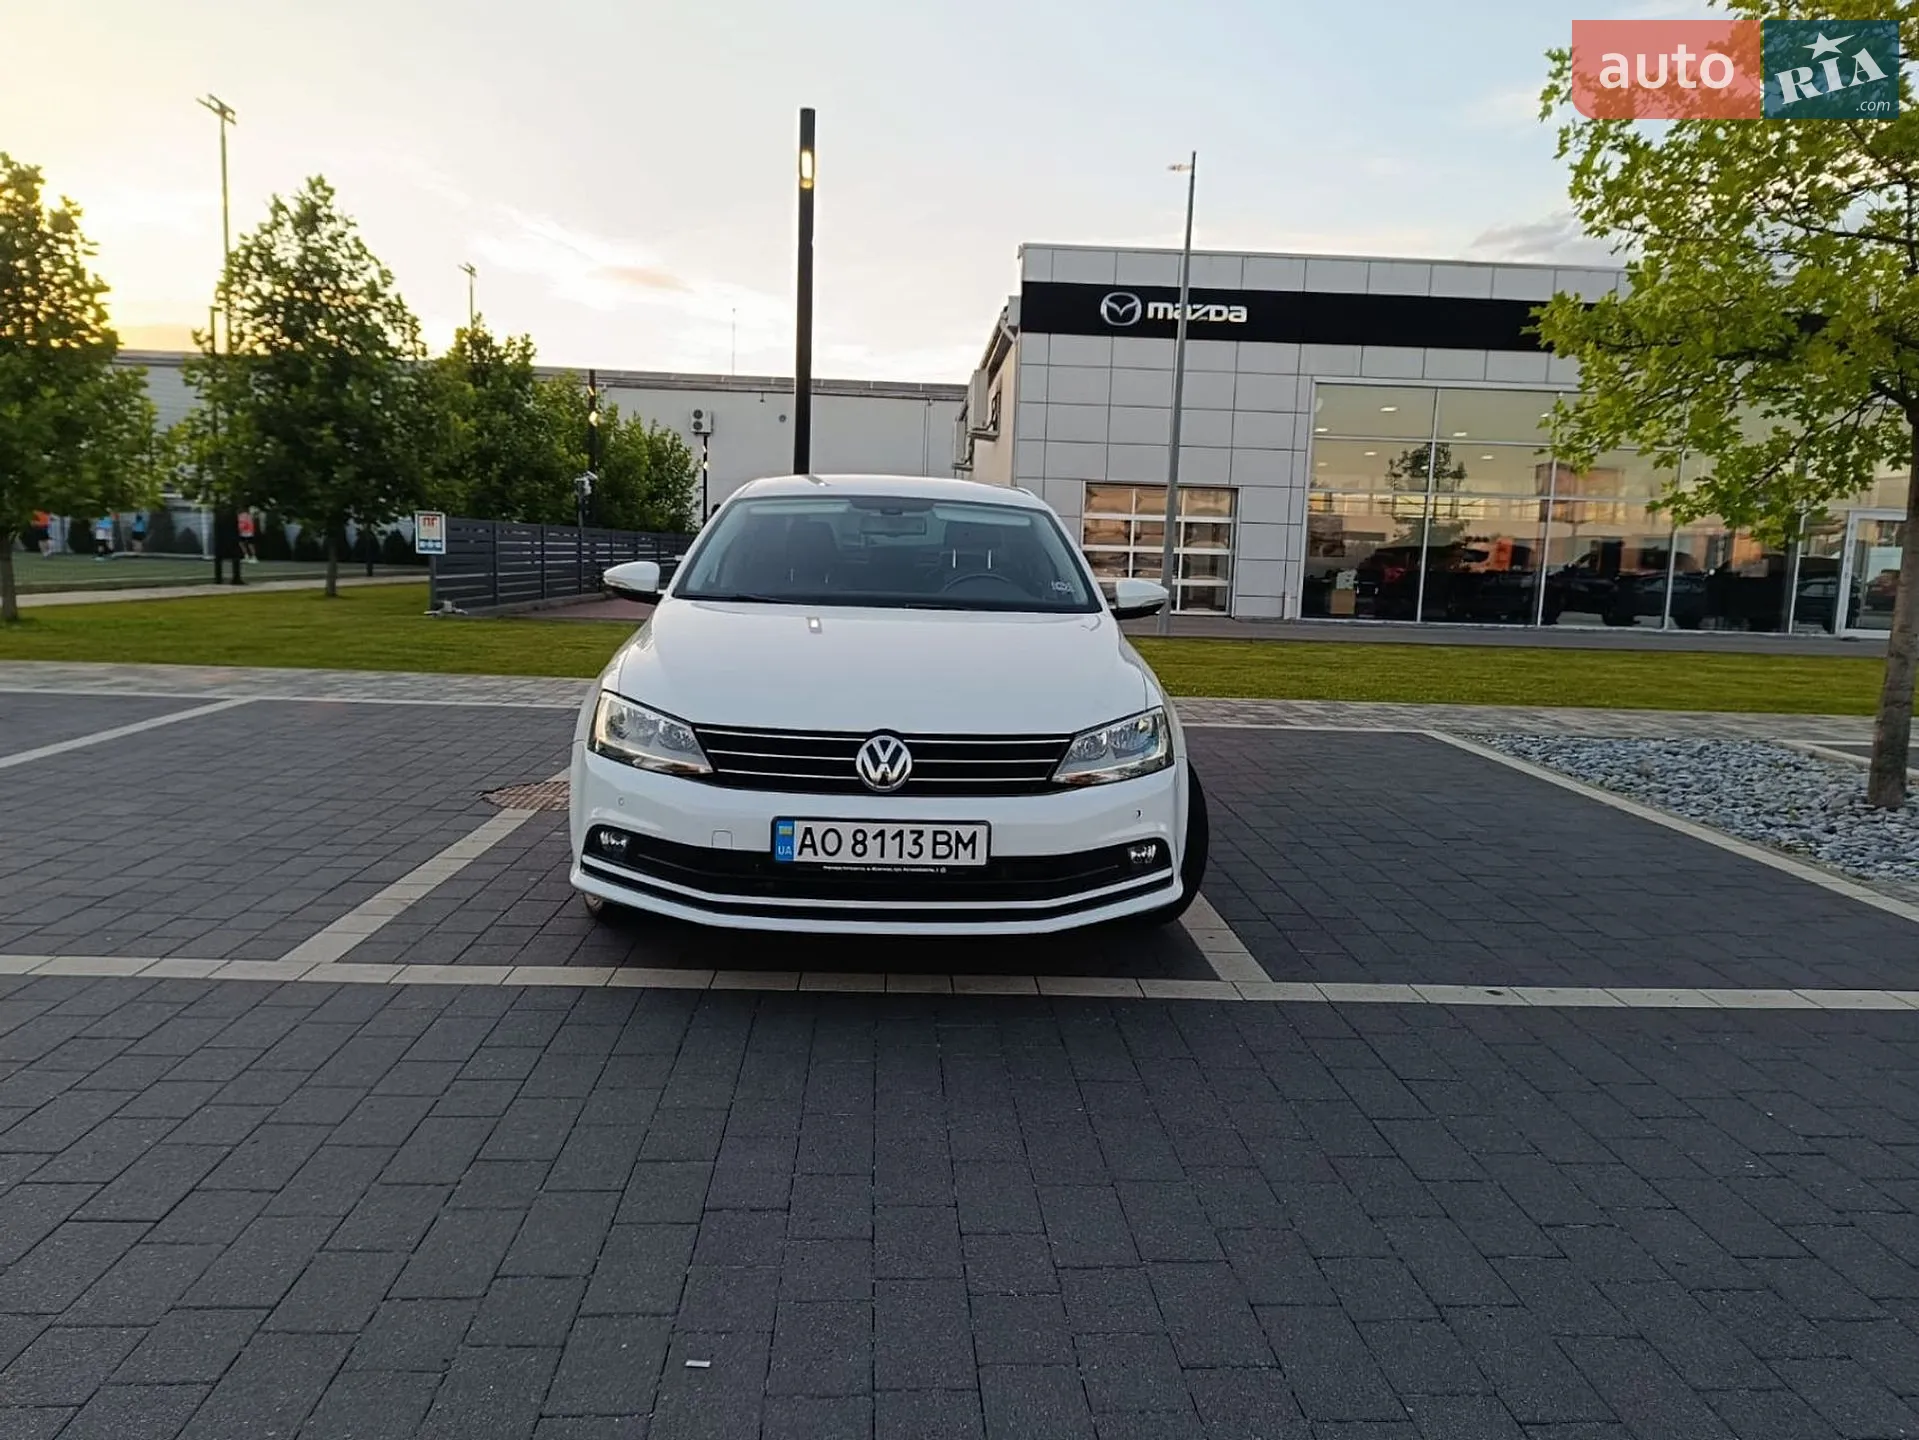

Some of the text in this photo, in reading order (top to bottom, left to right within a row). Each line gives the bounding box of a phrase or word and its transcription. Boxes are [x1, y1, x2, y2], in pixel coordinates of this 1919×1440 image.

[1147, 301, 1248, 323] mazda
[778, 845, 792, 856] UA
[797, 826, 977, 860] AO 8113 BM
